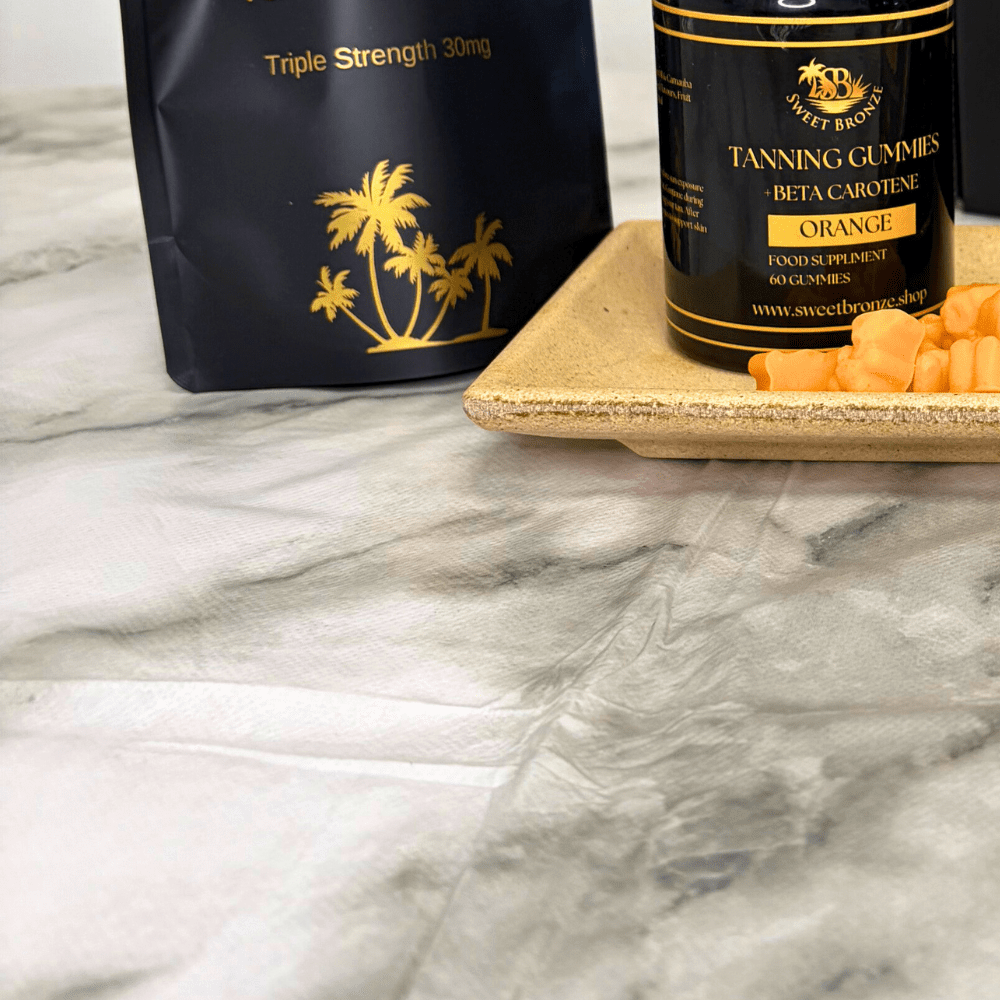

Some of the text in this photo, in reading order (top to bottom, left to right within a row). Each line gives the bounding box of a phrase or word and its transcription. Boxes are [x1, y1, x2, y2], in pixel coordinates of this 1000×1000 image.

[264, 36, 492, 79] Triple Strength 30mg
[786, 85, 884, 132] SWEET BRONZE
[728, 132, 940, 171] TANNING GUMMIES
[827, 173, 919, 200] CAROTENE
[799, 213, 893, 239] ORANGE
[768, 248, 888, 267] FOOD SUPPLIMENT
[769, 272, 851, 286] 60 GUMMIES
[752, 288, 928, 317] www.sweetbronze.shop
